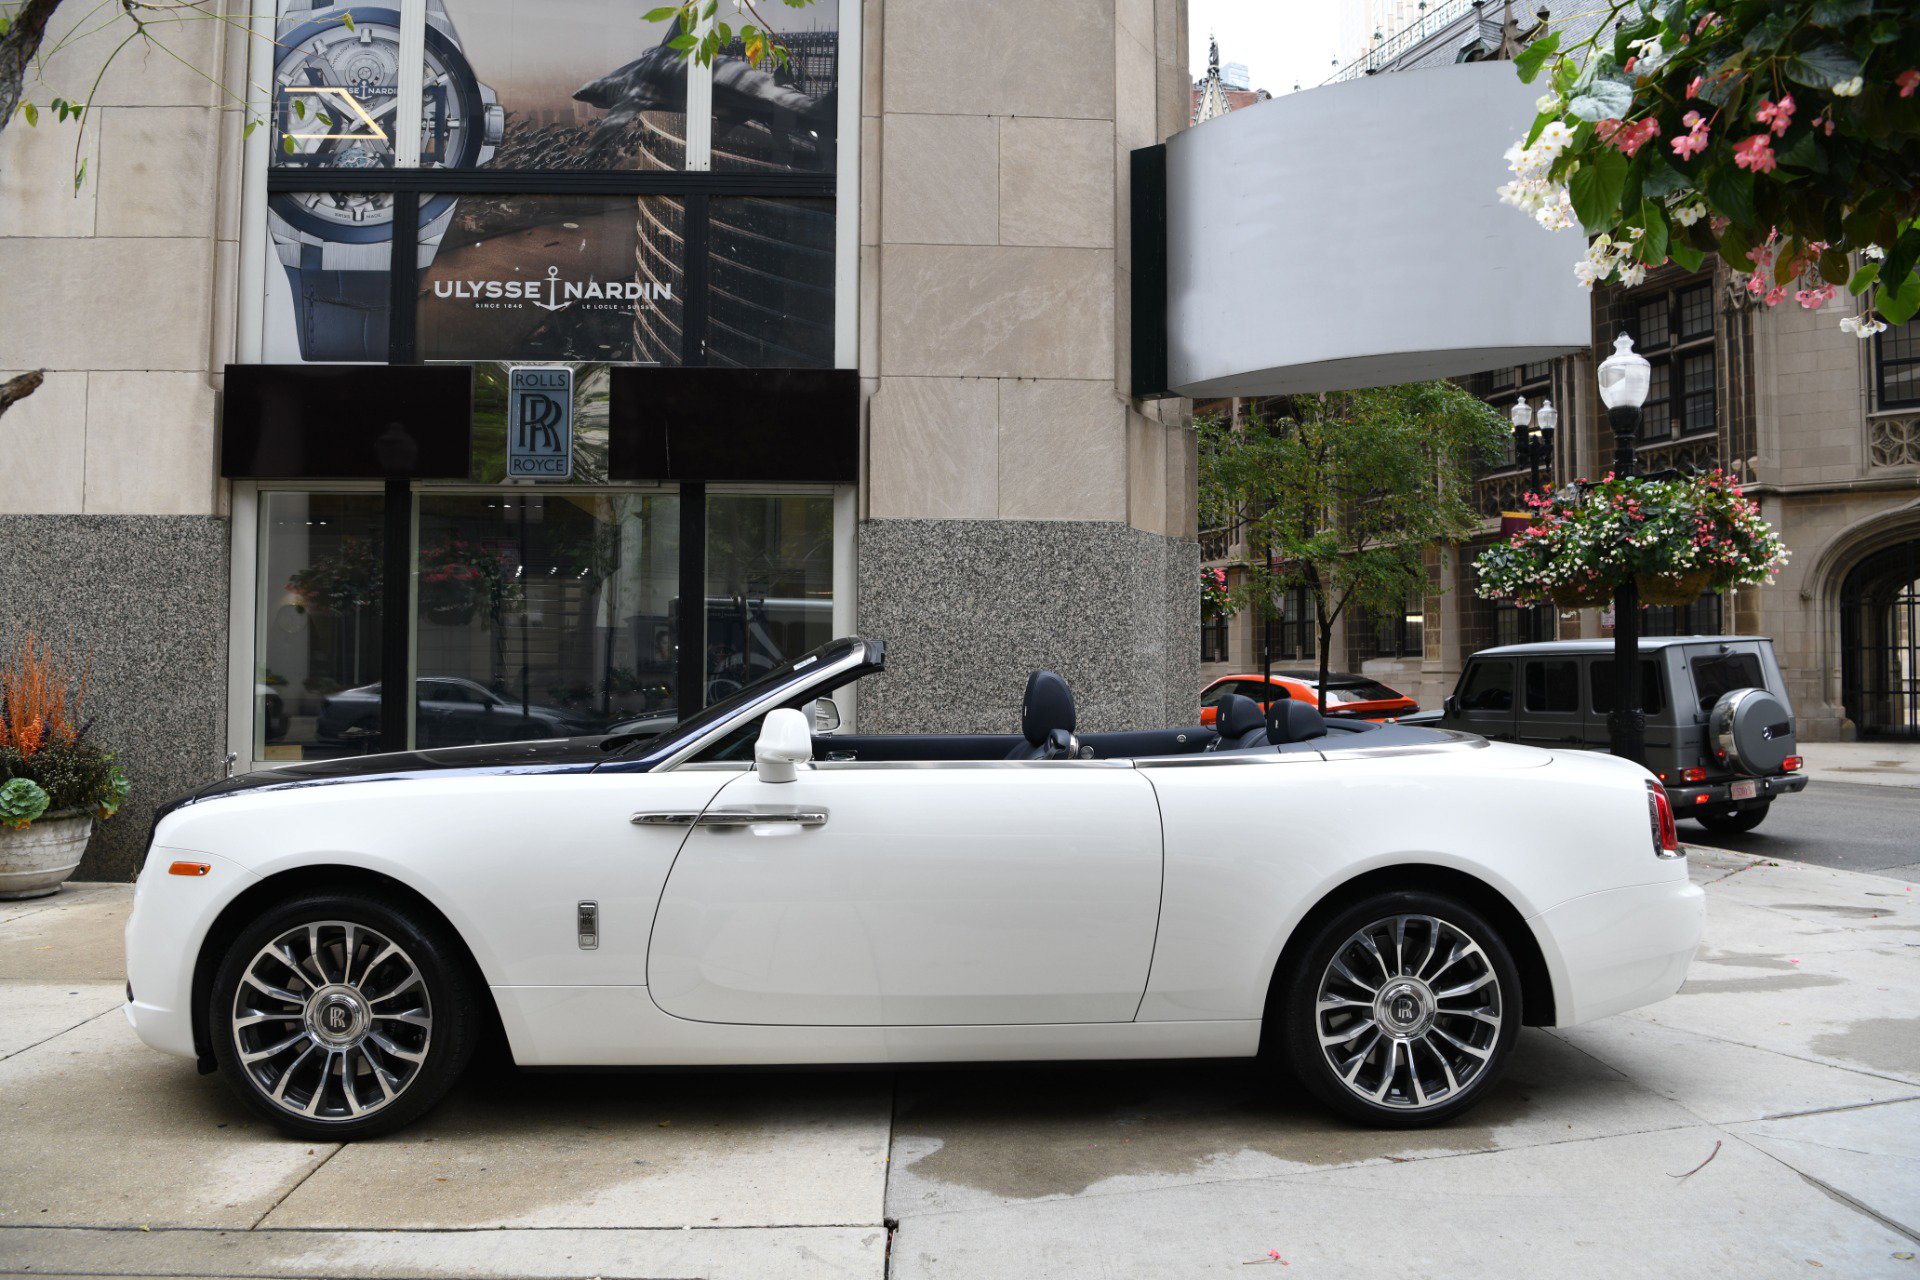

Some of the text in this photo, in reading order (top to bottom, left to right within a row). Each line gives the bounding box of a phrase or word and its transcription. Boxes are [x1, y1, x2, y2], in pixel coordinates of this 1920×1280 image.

[368, 87, 398, 95] NARDI
[434, 280, 672, 300] ULYSSE NARDIN
[515, 373, 566, 387] ROLLS
[518, 393, 562, 453] RR
[513, 458, 564, 472] ROYCE
